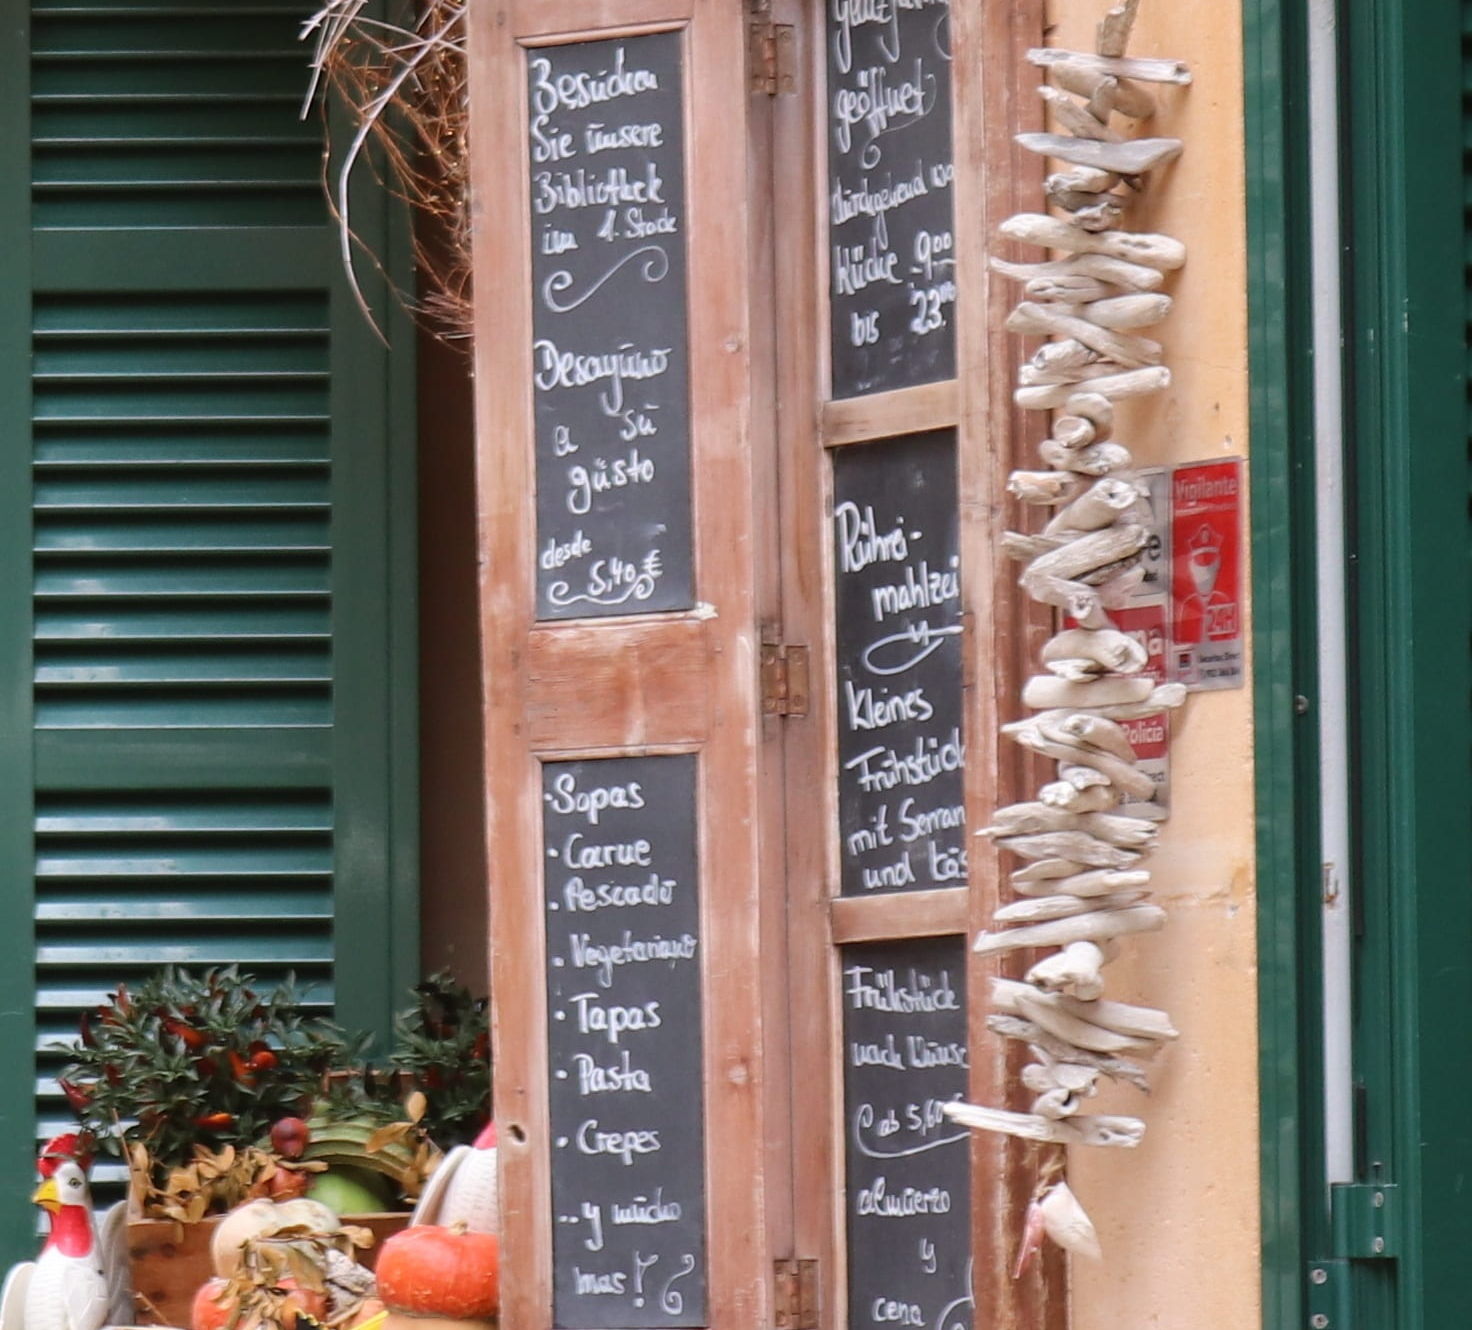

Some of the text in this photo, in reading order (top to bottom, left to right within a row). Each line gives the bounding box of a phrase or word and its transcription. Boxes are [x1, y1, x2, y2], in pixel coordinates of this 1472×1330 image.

[835, 57, 927, 153] geöffnet
[531, 115, 577, 162] Sie
[542, 223, 579, 255] im
[850, 310, 881, 347] bis
[555, 424, 579, 457] a
[540, 529, 593, 570] desde
[642, 548, 664, 580] €
[844, 679, 935, 732] Kleines
[551, 772, 646, 825] Sopas
[846, 803, 894, 856] mit
[862, 851, 917, 890] und
[563, 872, 678, 913] Pescado
[568, 992, 663, 1044] Tapas
[572, 1049, 652, 1096] Pasta
[575, 1119, 662, 1166] Crepes
[918, 1238, 937, 1273] y
[872, 1296, 926, 1328] cena
